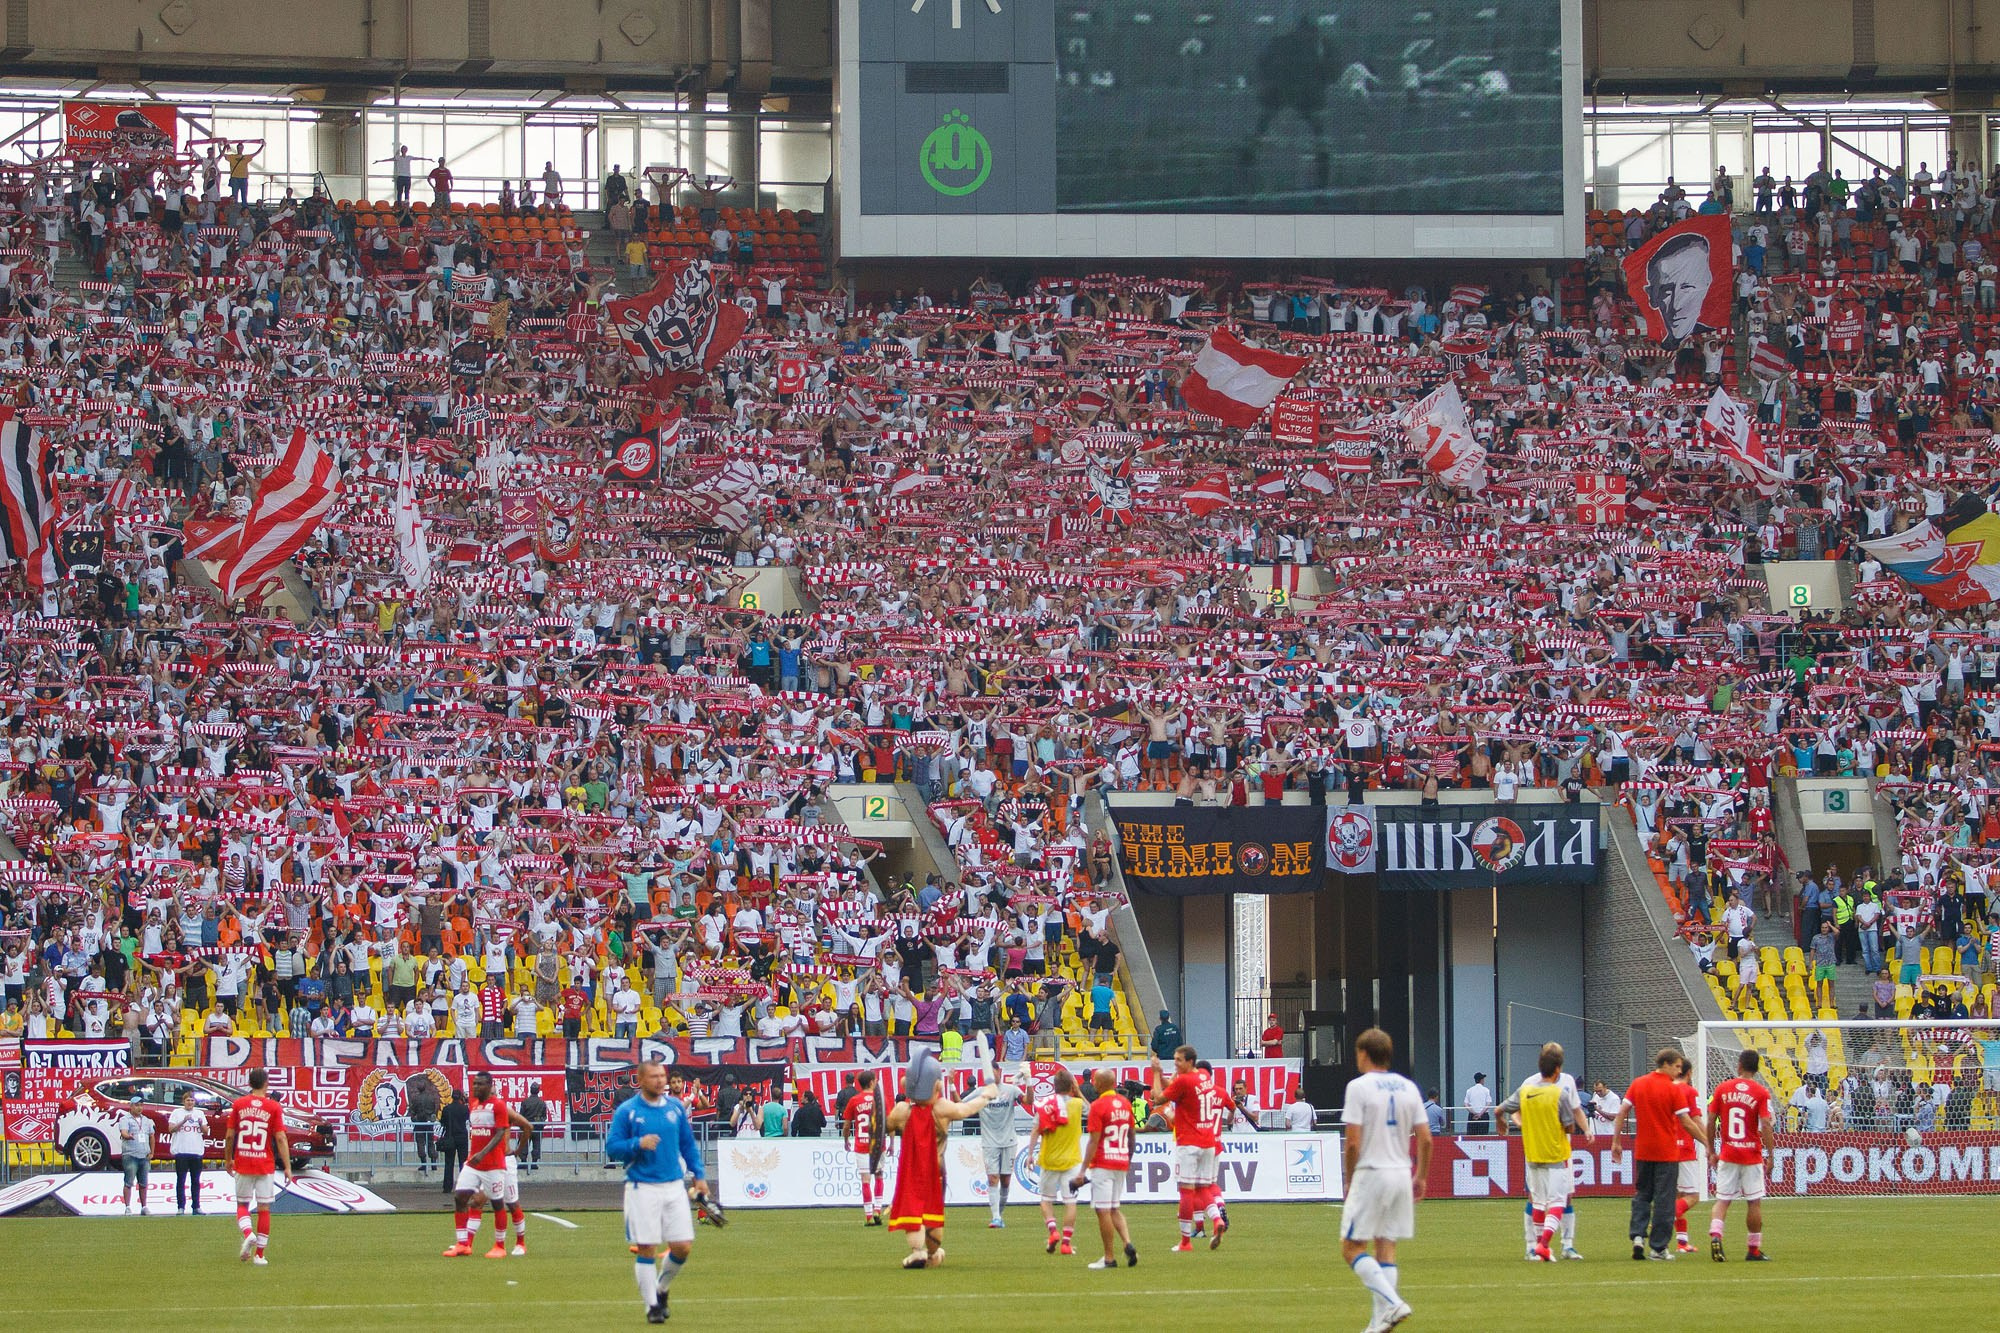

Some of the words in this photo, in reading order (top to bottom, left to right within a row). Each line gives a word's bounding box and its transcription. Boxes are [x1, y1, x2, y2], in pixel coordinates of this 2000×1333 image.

[1278, 424, 1313, 435] ULTRAS
[1585, 477, 1591, 488] F
[1610, 477, 1616, 488] C
[1585, 510, 1592, 521] S
[1608, 510, 1616, 521] M
[742, 594, 757, 610] 8
[1794, 586, 1808, 605] 8
[870, 797, 884, 818] 2
[1829, 791, 1844, 811] 3
[1119, 823, 1184, 844] THE
[25, 1069, 47, 1078] МЫ
[55, 1069, 131, 1079] ГОРДИМСЯ
[1031, 1063, 1056, 1072] 100%
[25, 1080, 63, 1089] ЭТИМ
[25, 1091, 45, 1099] ИЗ
[56, 1091, 74, 1099] КУ
[45, 1102, 60, 1110] НИК
[1387, 1095, 1397, 1125] 1
[1212, 1109, 1222, 1135] 7
[1728, 1108, 1747, 1140] 6
[238, 1120, 269, 1151] 25
[1104, 1124, 1130, 1155] 20
[1135, 1142, 1172, 1156] ОЛЫ,
[814, 1183, 862, 1198] СОЮЗ
[83, 1195, 125, 1205] KIA
